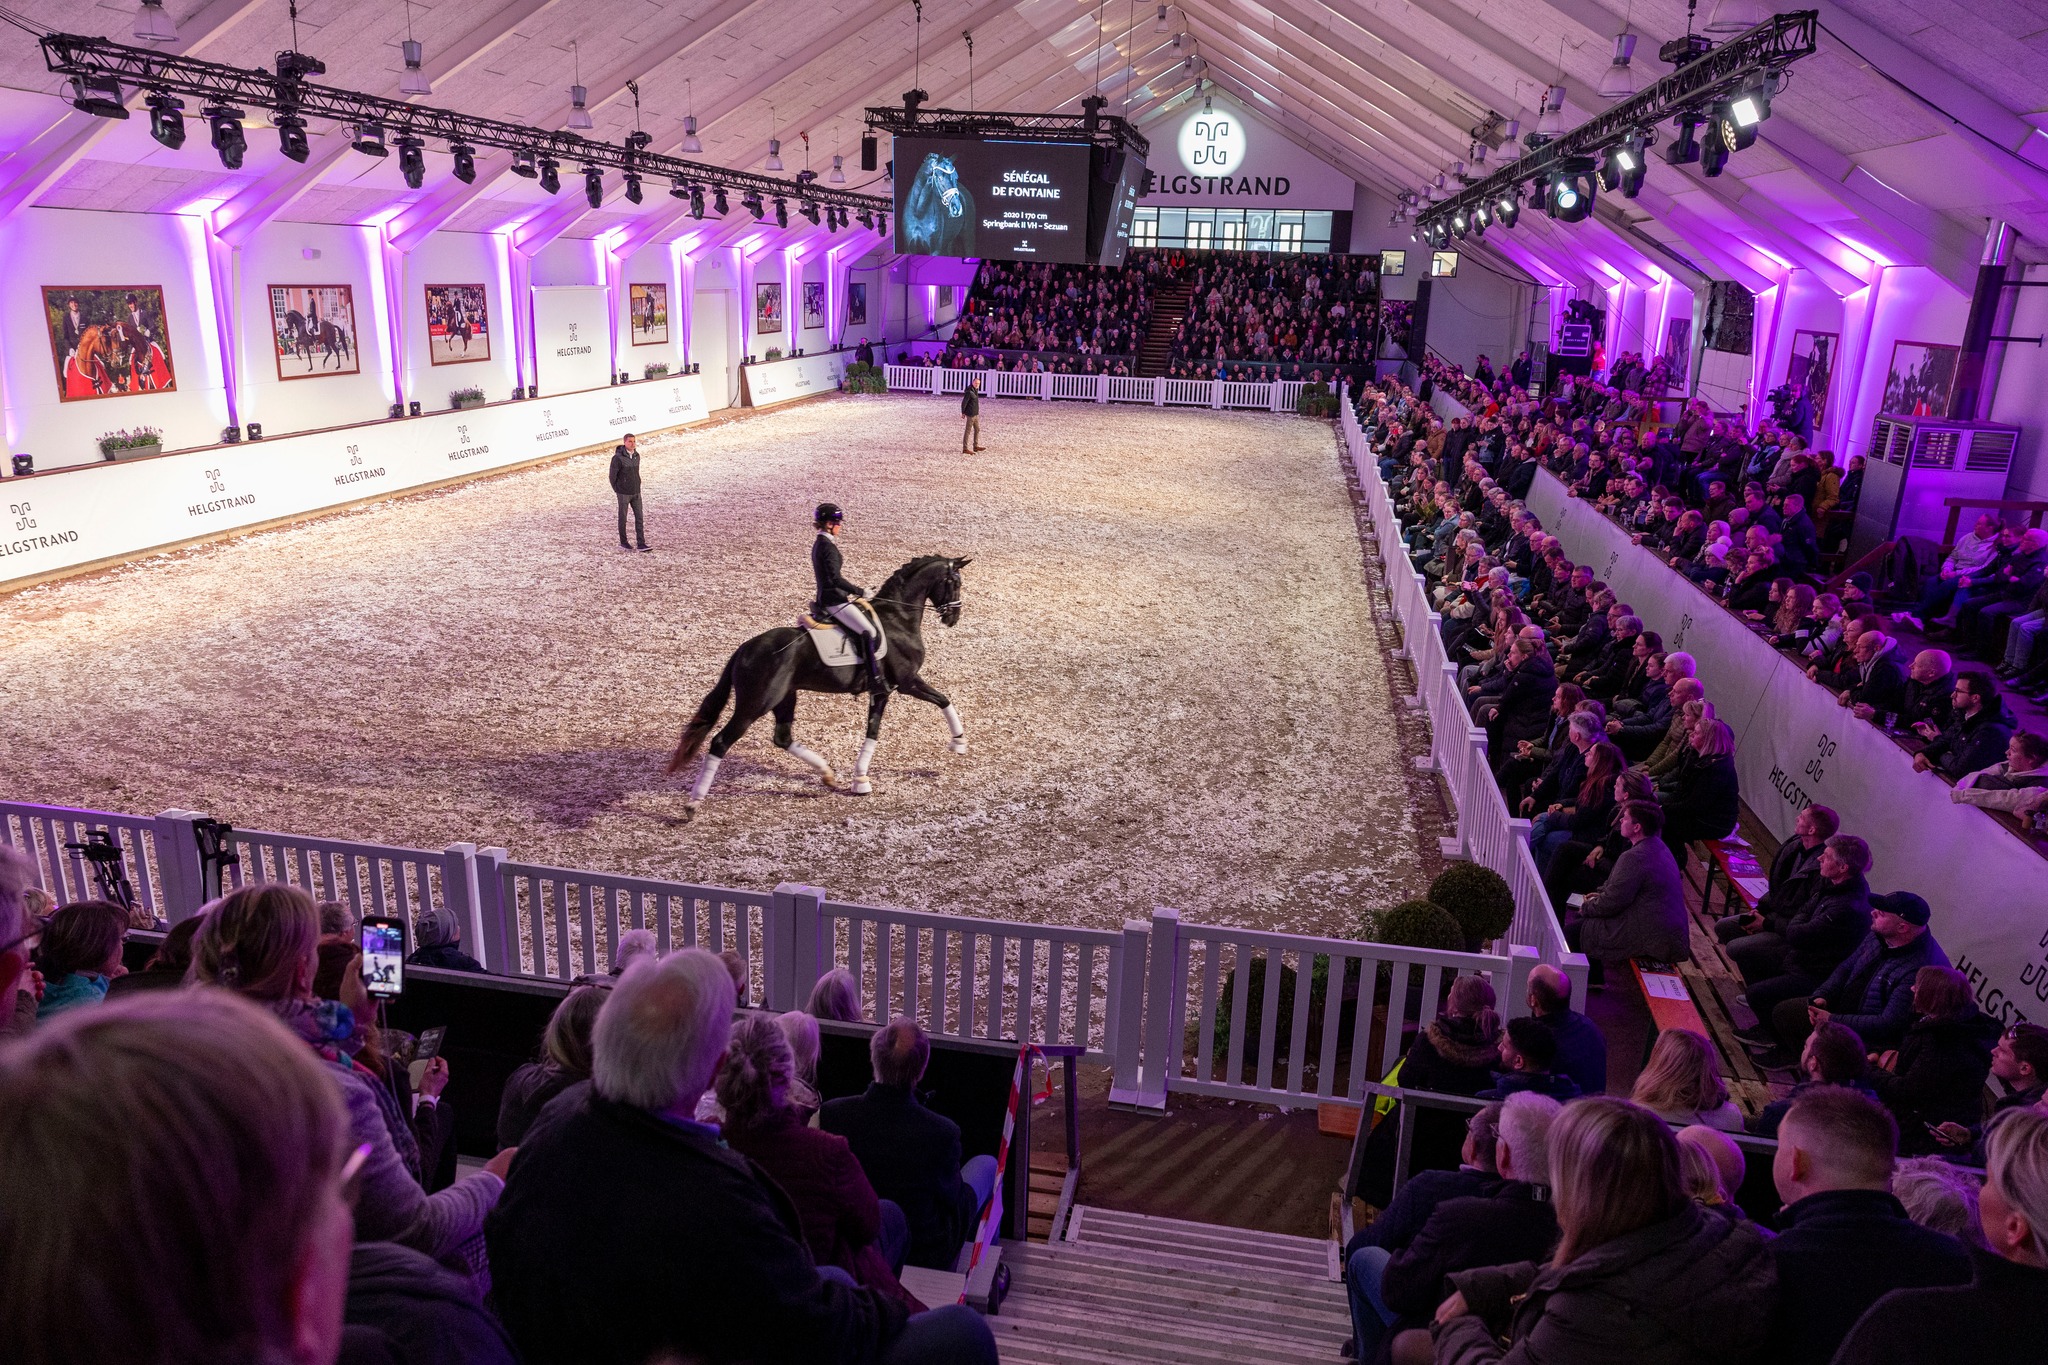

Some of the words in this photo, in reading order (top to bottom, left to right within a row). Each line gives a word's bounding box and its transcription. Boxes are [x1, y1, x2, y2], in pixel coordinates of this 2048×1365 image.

[1003, 170, 1050, 184] SÉNÉGAL
[992, 186, 1007, 196] DE
[1008, 187, 1061, 199] FONTAINE
[1148, 175, 1291, 196] ELGSTRAND
[1003, 211, 1020, 219] 2020
[1025, 212, 1036, 220] 170
[982, 219, 1020, 229] Springbank
[1027, 221, 1038, 229] VH
[1043, 222, 1068, 231] Sezuan
[556, 345, 592, 358] HELGSTRAND
[608, 414, 637, 426] HELGSTRAND
[535, 428, 570, 442] HELGSTRAND
[447, 445, 490, 462] HELGSTRAND
[334, 466, 386, 486] HELGSTRAND
[187, 493, 256, 517] HELGSTRAND
[0, 530, 79, 557] ELGSTRAND
[1768, 763, 1813, 811] HELGST
